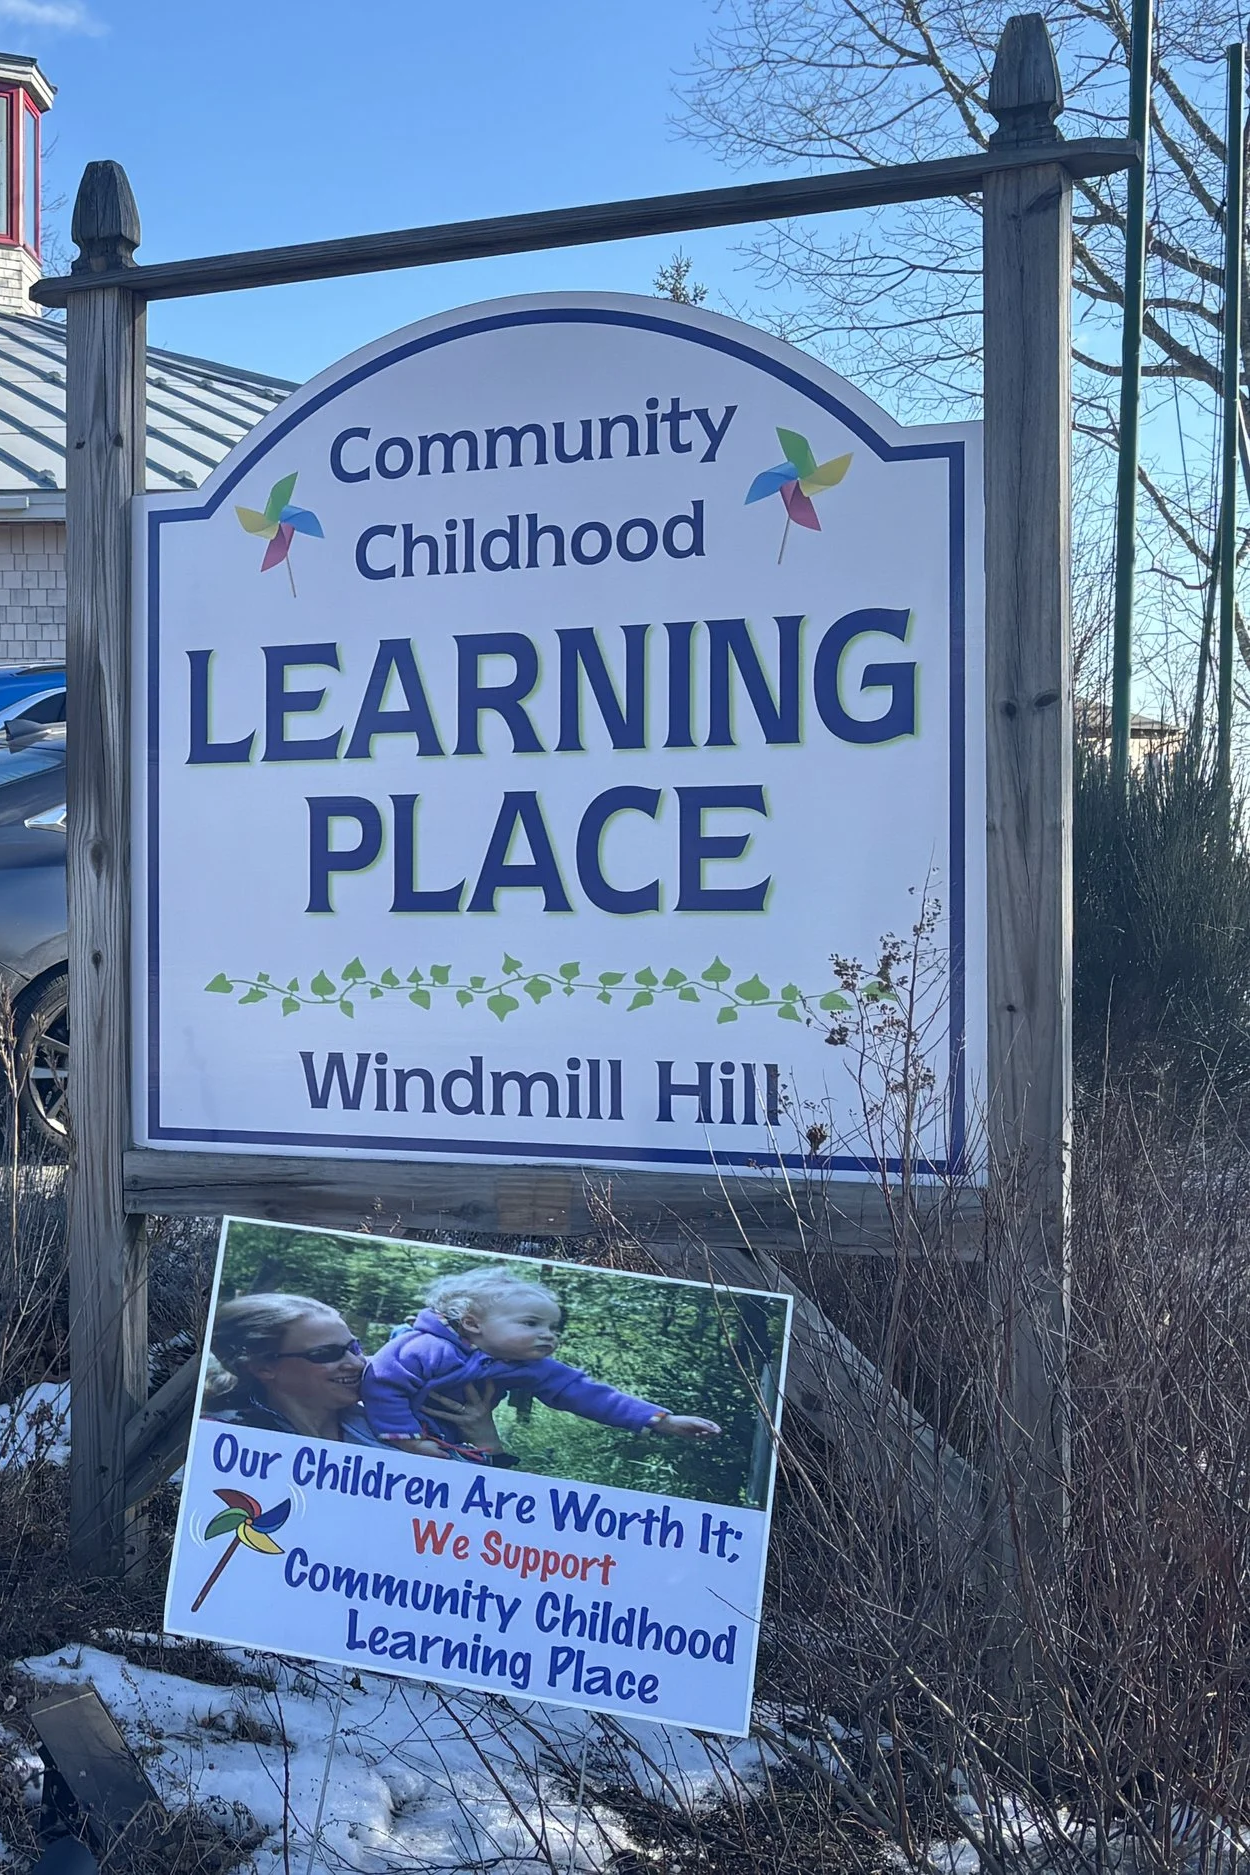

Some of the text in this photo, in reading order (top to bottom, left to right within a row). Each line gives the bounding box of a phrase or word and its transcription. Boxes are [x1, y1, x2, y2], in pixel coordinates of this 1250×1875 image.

[330, 397, 738, 483] Community
[356, 500, 705, 580] Childhood
[185, 608, 919, 766] LEARNING
[304, 785, 772, 916] PLACE
[299, 1051, 781, 1126] Windmill Hill
[212, 1432, 282, 1480] Our
[292, 1446, 449, 1509] Children
[461, 1475, 536, 1524] Are
[550, 1488, 684, 1548] Worth
[412, 1518, 616, 1585] We Support
[284, 1547, 737, 1664] Community Childhood
[346, 1608, 660, 1704] Learning Place
